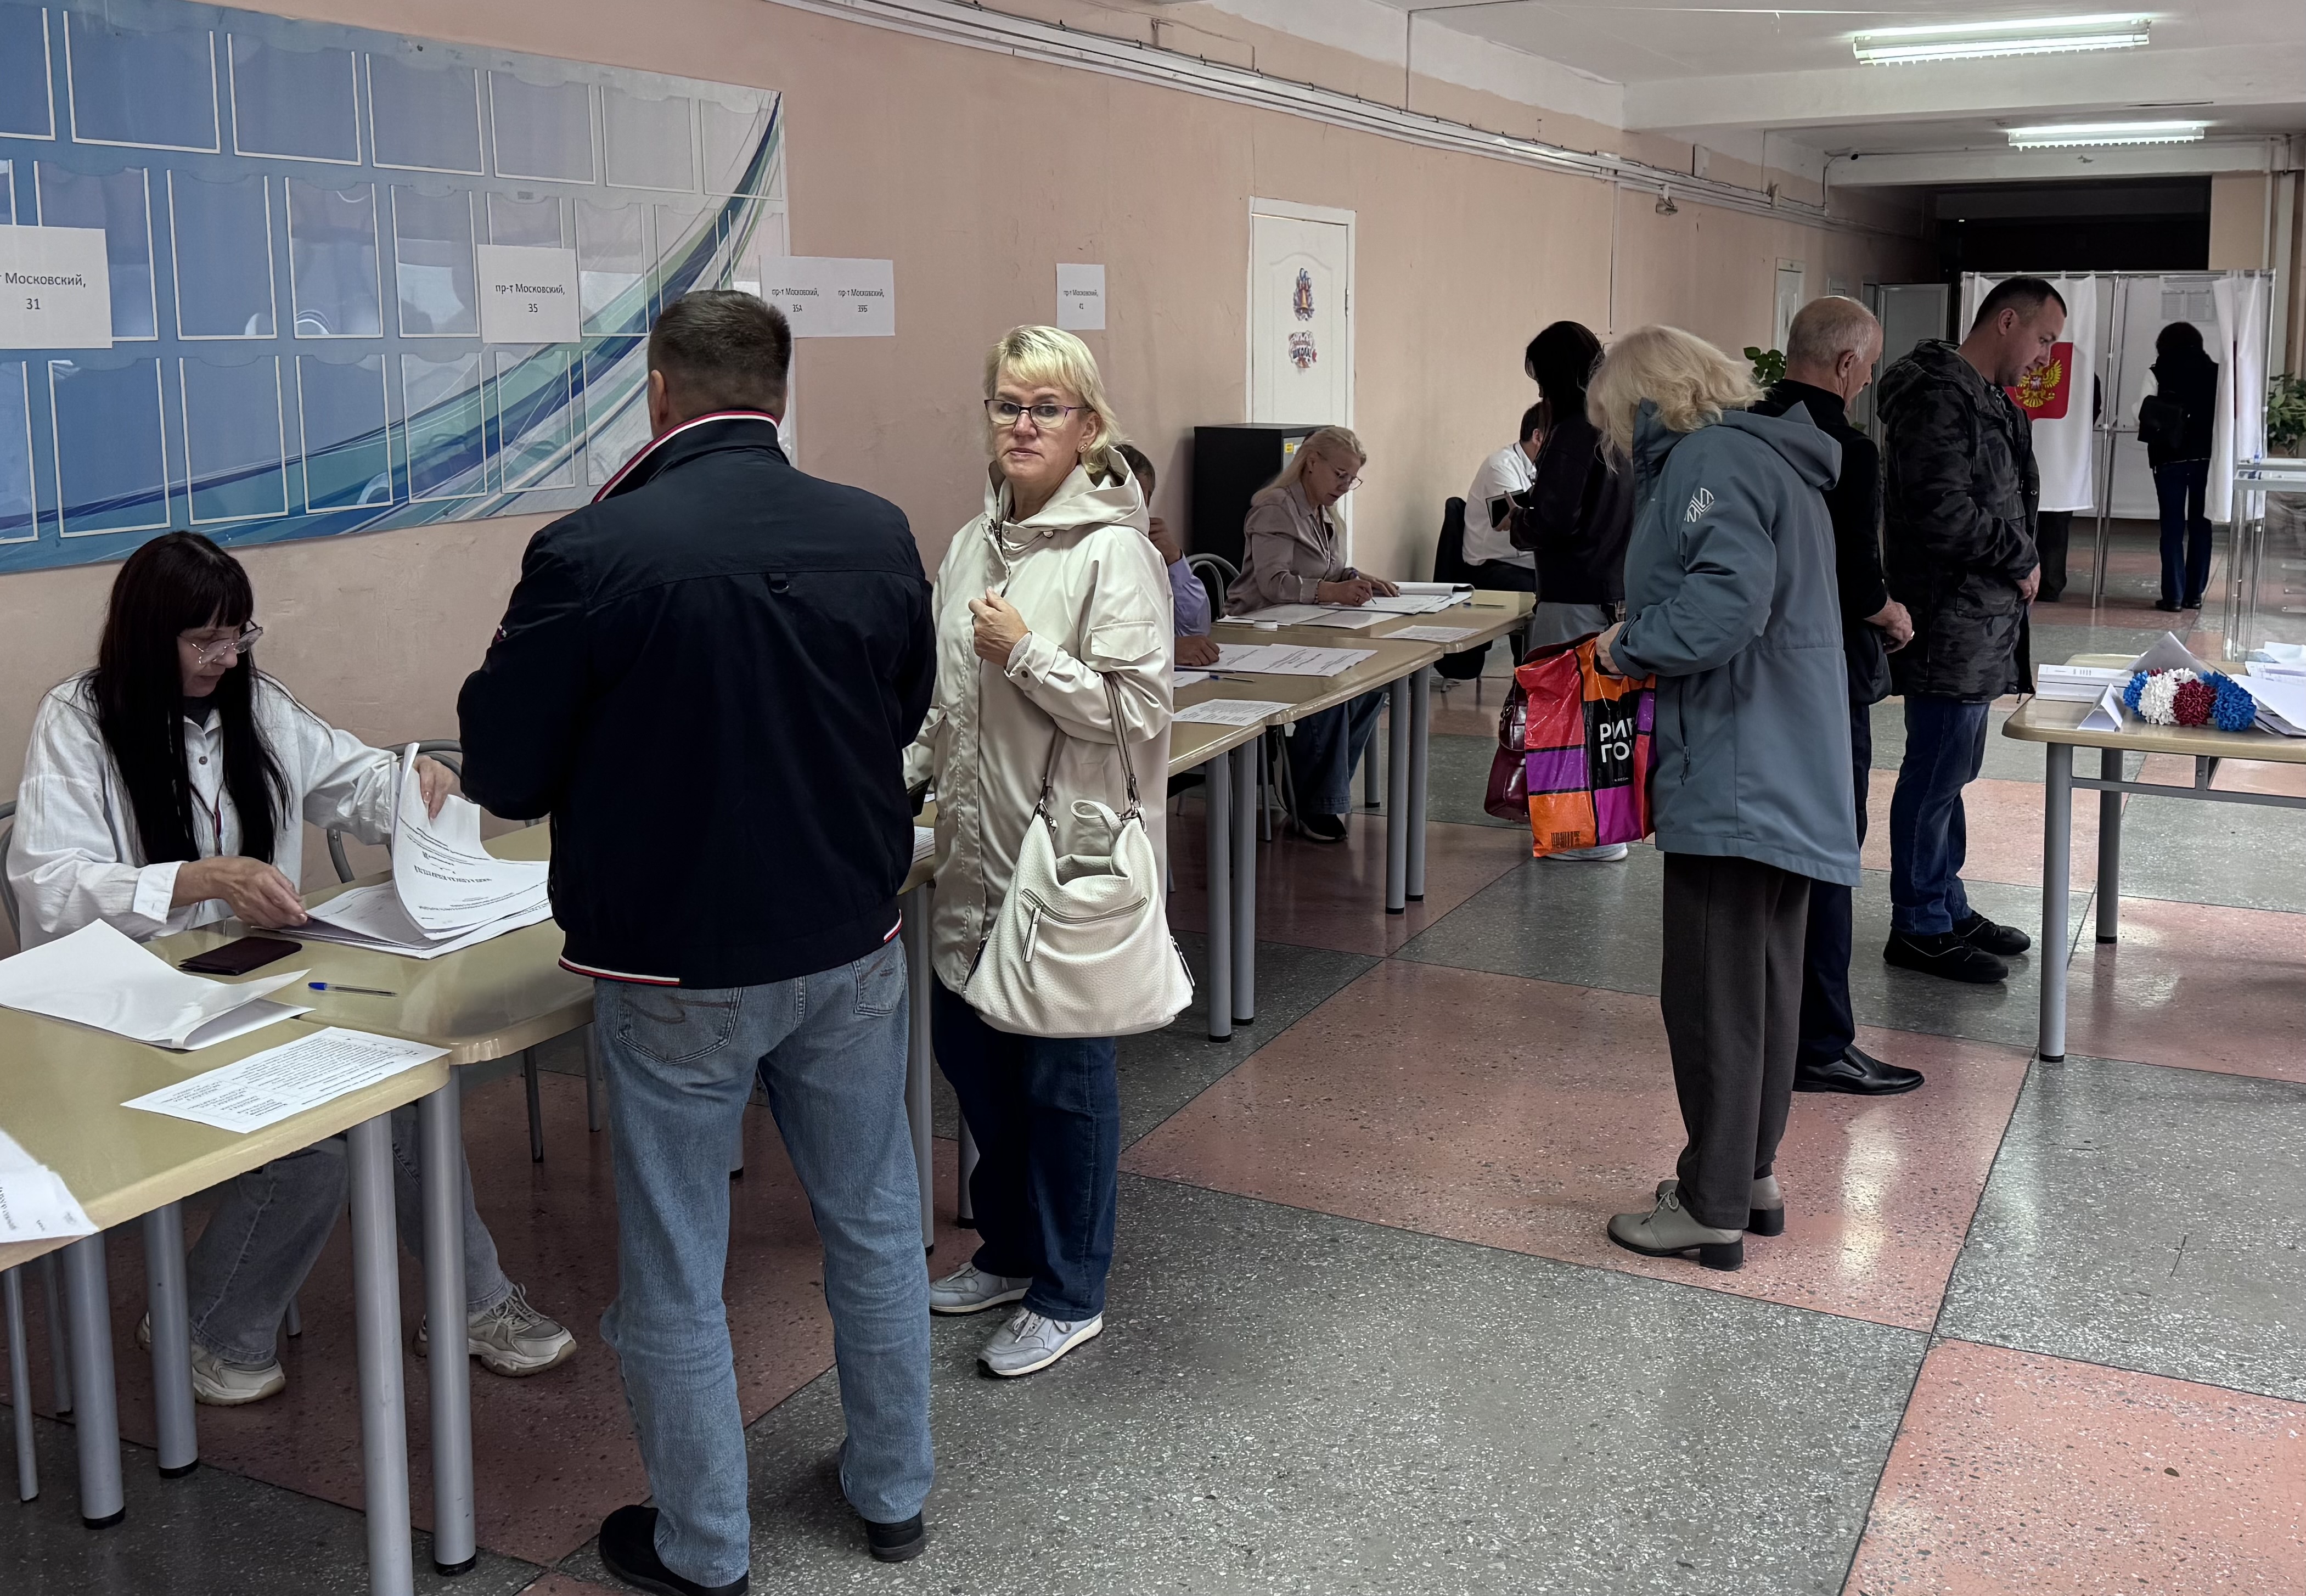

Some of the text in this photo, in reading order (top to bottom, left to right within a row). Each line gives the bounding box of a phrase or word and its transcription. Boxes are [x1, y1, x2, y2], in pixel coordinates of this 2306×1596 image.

[5, 272, 86, 288] Московский,
[496, 283, 565, 295] пр-т Московский,
[26, 298, 41, 310] 31
[528, 304, 538, 312] 35
[1601, 739, 1634, 762] ГО
